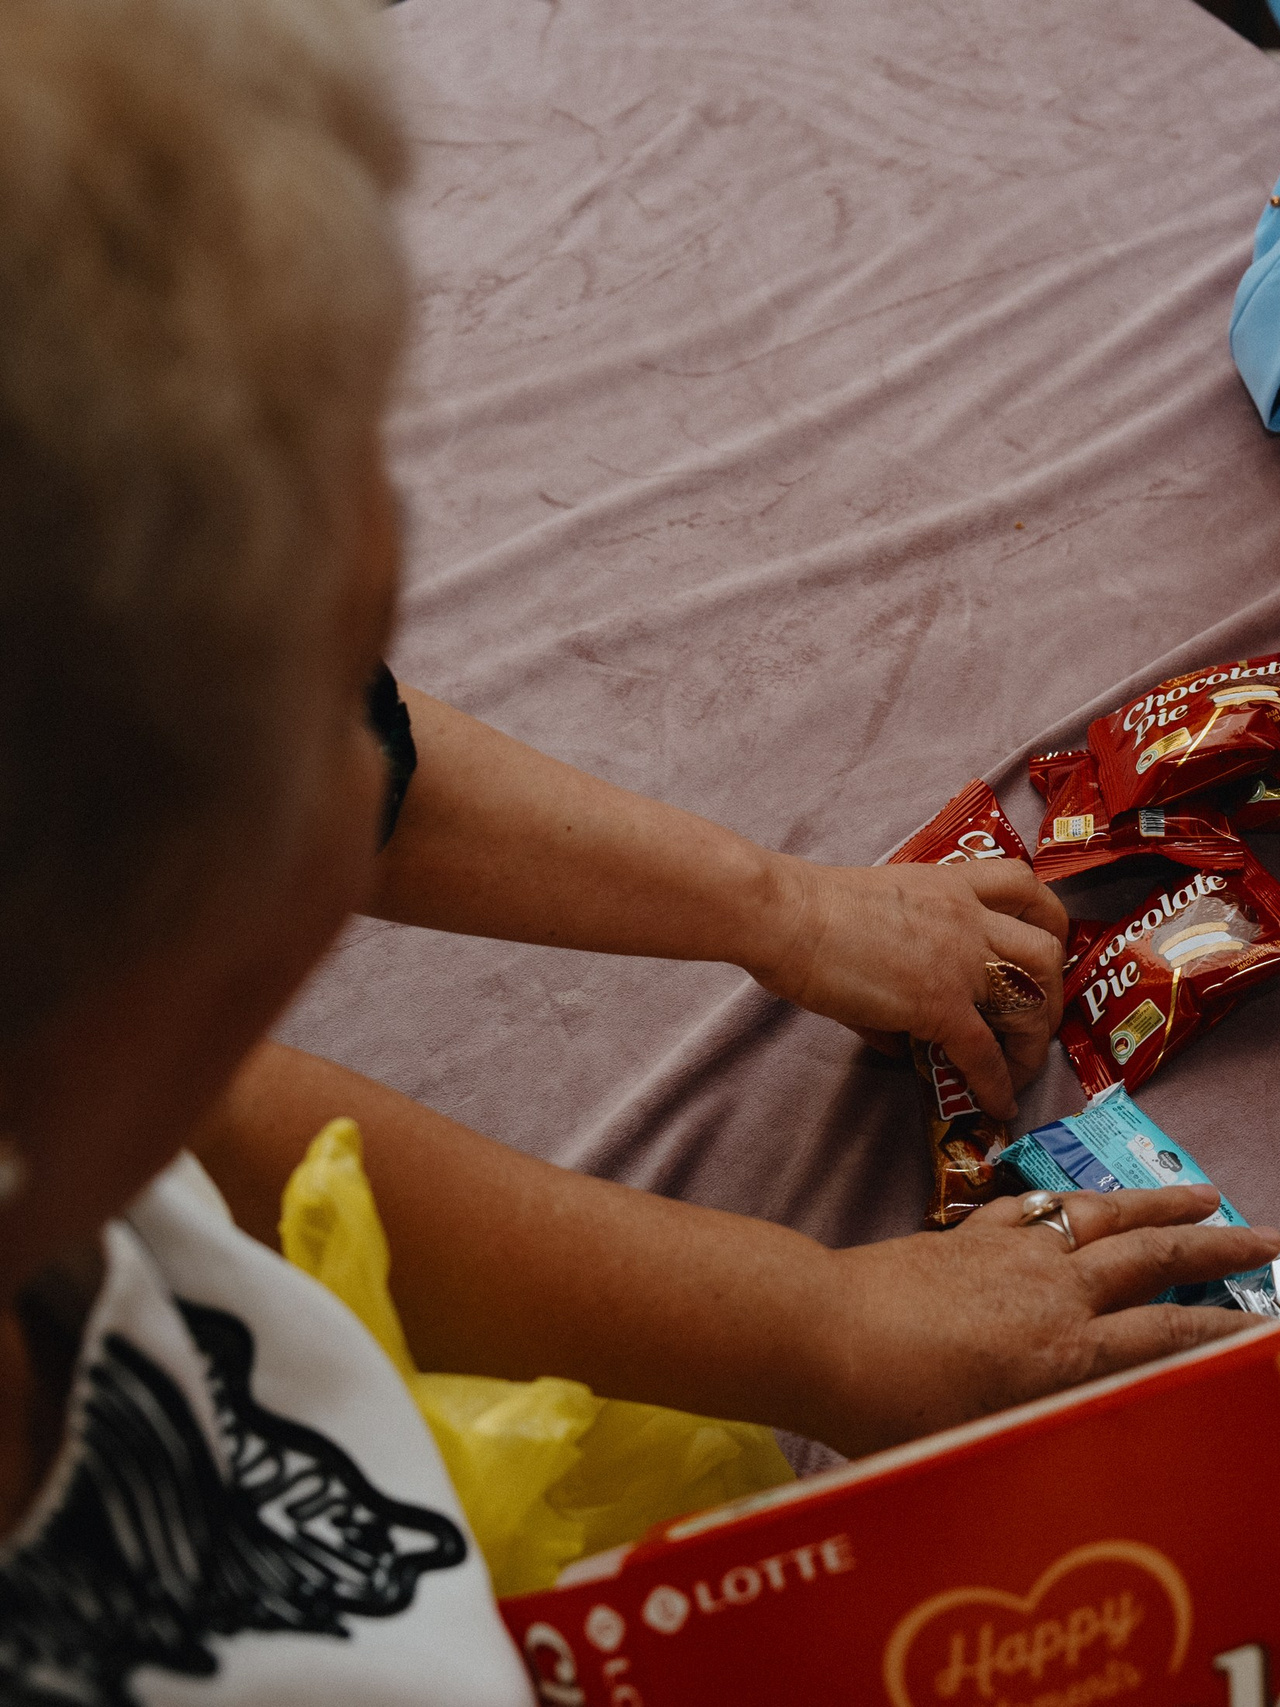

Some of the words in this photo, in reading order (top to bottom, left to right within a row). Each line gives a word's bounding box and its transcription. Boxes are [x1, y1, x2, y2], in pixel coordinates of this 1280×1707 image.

[1133, 702, 1188, 750] Pie
[998, 816, 1026, 851] LOTTE
[1092, 873, 1228, 972] ocolate
[1082, 957, 1141, 1025] Pie
[695, 1534, 856, 1612] LOTTE
[935, 1587, 1146, 1700] Happy
